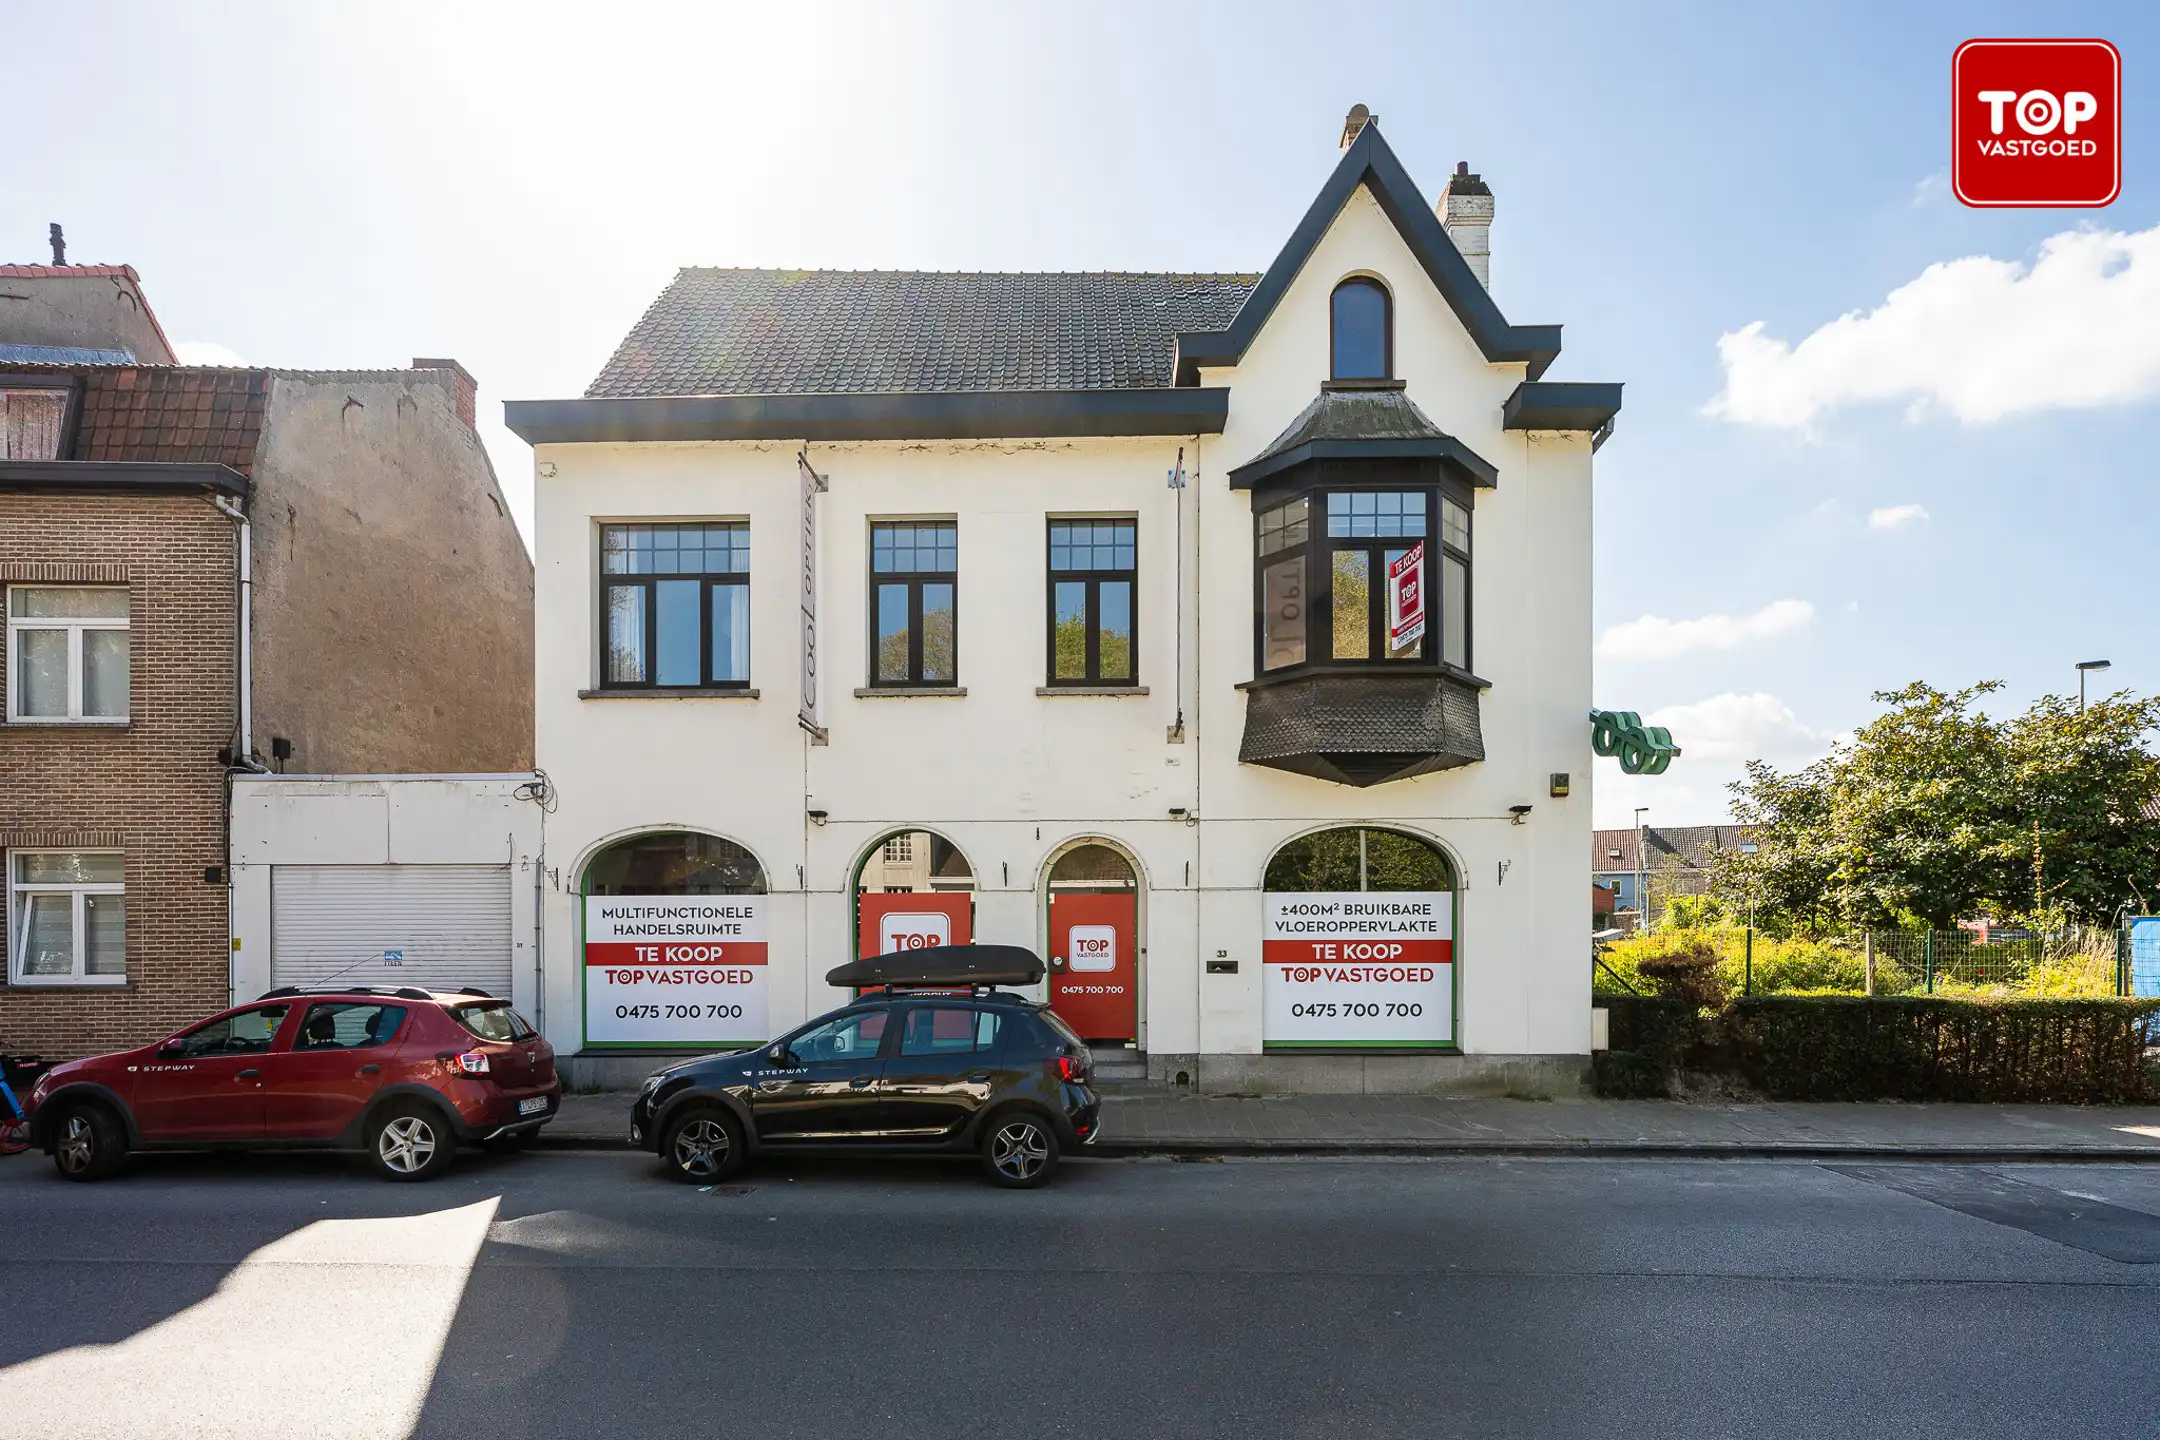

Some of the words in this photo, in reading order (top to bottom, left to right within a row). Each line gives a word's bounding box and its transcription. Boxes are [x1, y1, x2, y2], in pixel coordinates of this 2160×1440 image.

[804, 486, 814, 596] OPTIEK
[1394, 559, 1403, 575] TE
[1403, 545, 1422, 568] KOOP
[1400, 581, 1417, 601] TOP
[602, 907, 754, 919] MULTIFUNCTIONELE
[1344, 904, 1432, 915] BRUIKBARE
[613, 924, 742, 935] HANDELSRUIMTE
[1275, 921, 1437, 932] VLOEROPPERVLAKTE
[890, 933, 942, 953] TOP
[1076, 939, 1110, 952] TOP
[635, 946, 659, 962] TE
[665, 946, 723, 962] KOOP
[1216, 949, 1228, 958] 33
[1312, 944, 1337, 960] TE
[1343, 944, 1403, 960] KOOP
[1061, 985, 1084, 994] 0475
[1085, 985, 1104, 994] 700
[1105, 985, 1124, 994] 700
[615, 1005, 660, 1019] 0475
[665, 1005, 701, 1019] 700
[706, 1005, 743, 1019] 700
[1291, 1003, 1337, 1017] 0475
[1343, 1003, 1380, 1017] 700
[1385, 1003, 1423, 1017] 700
[143, 1064, 195, 1072] STEPWAY
[758, 1068, 809, 1076] STEPWAY
